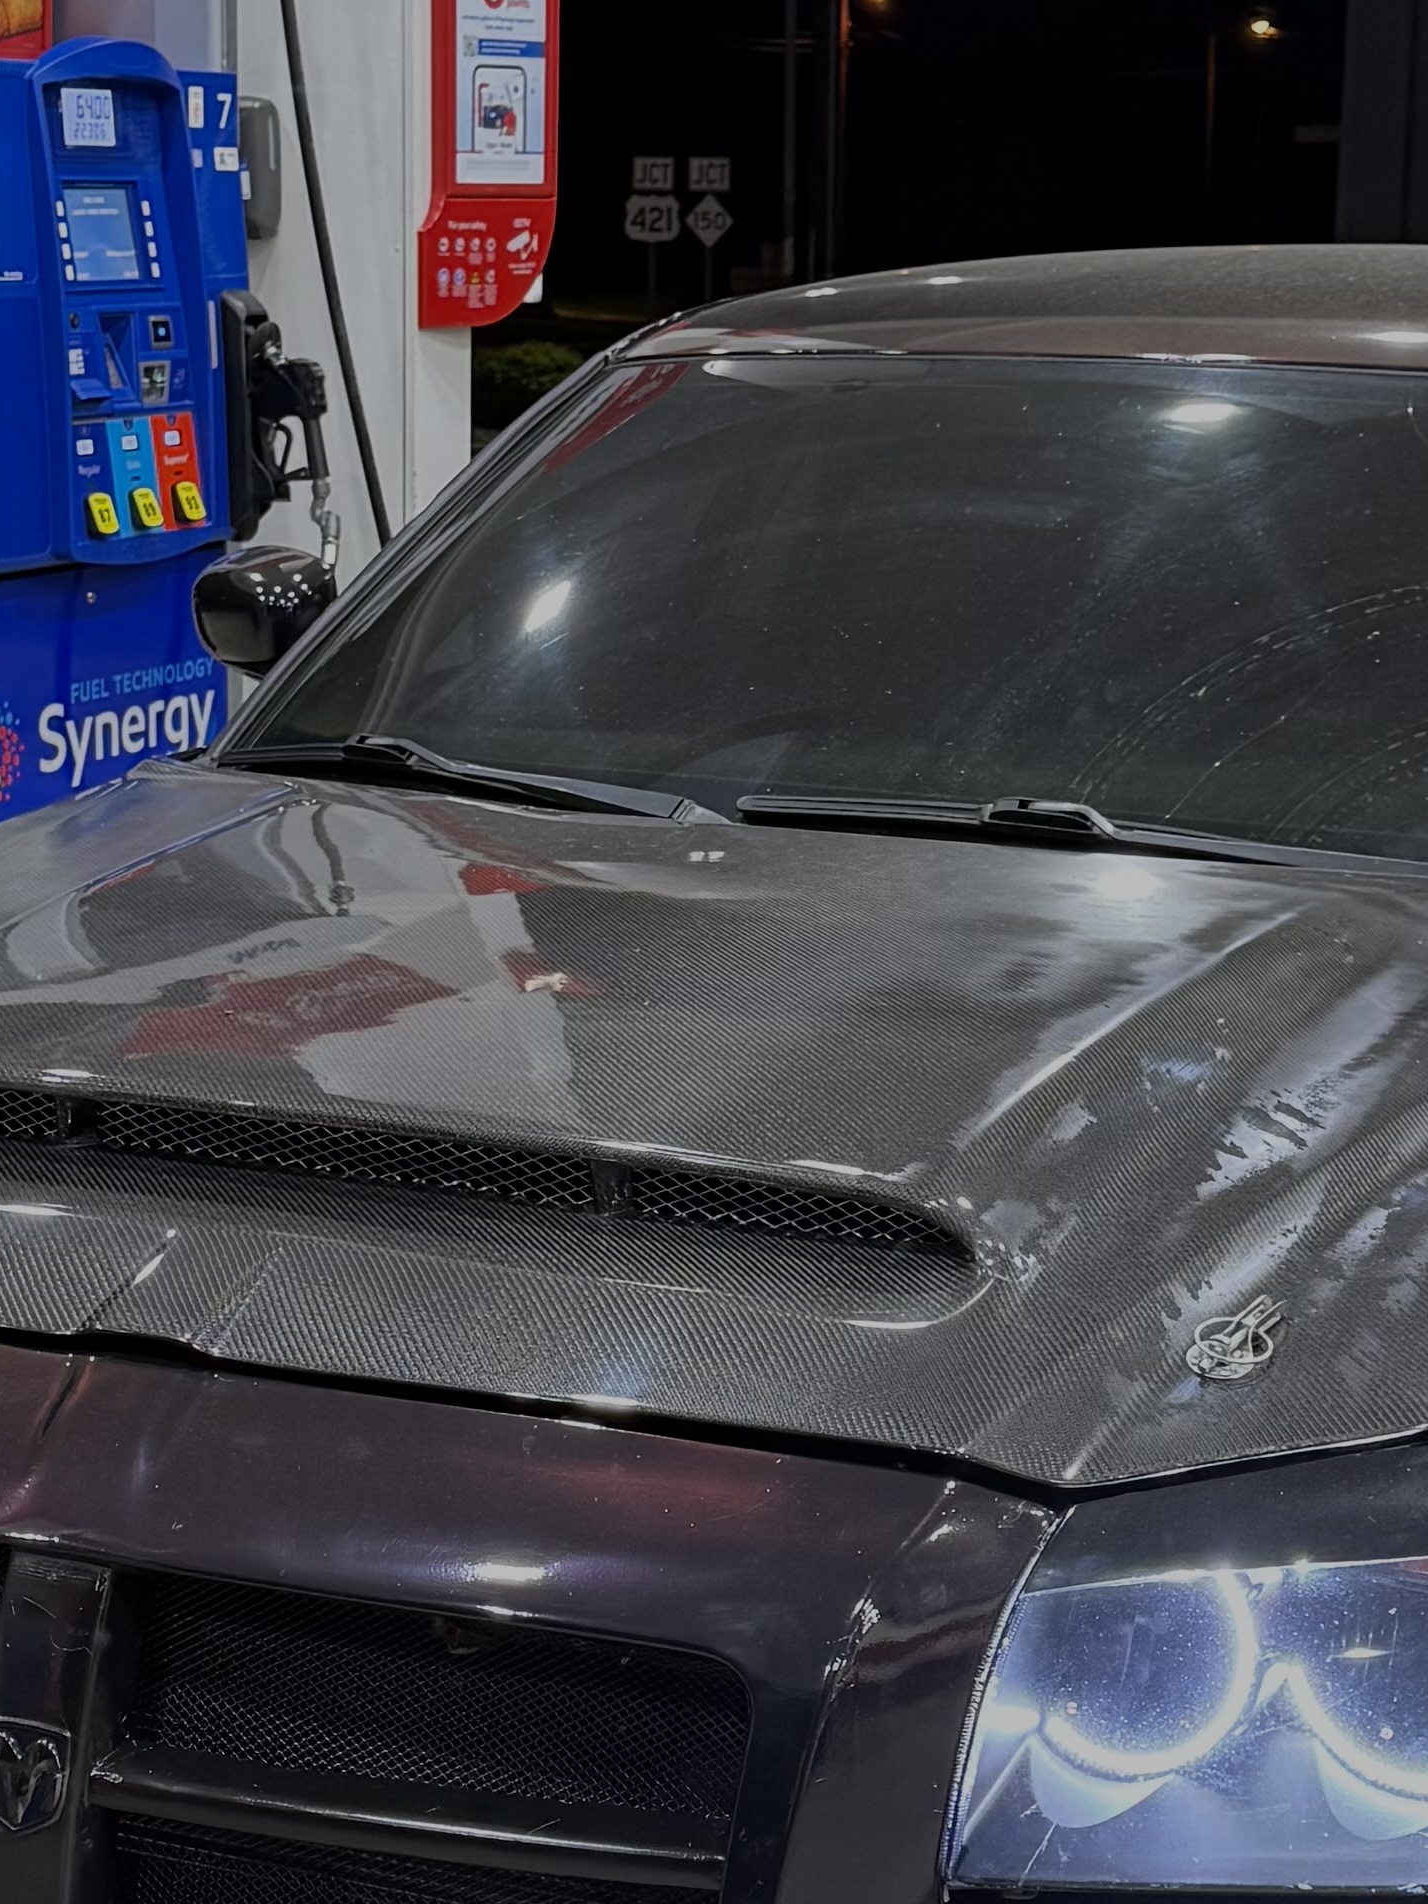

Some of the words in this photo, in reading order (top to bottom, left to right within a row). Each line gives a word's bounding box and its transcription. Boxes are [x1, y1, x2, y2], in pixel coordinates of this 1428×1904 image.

[216, 92, 233, 129] 7
[637, 162, 670, 184] JCT
[694, 163, 728, 185] JCT
[630, 207, 673, 233] 421
[694, 211, 727, 231] 150
[71, 678, 110, 704] FUEL
[113, 656, 214, 695] TECHNOLOGY
[38, 689, 215, 788] Synergy
